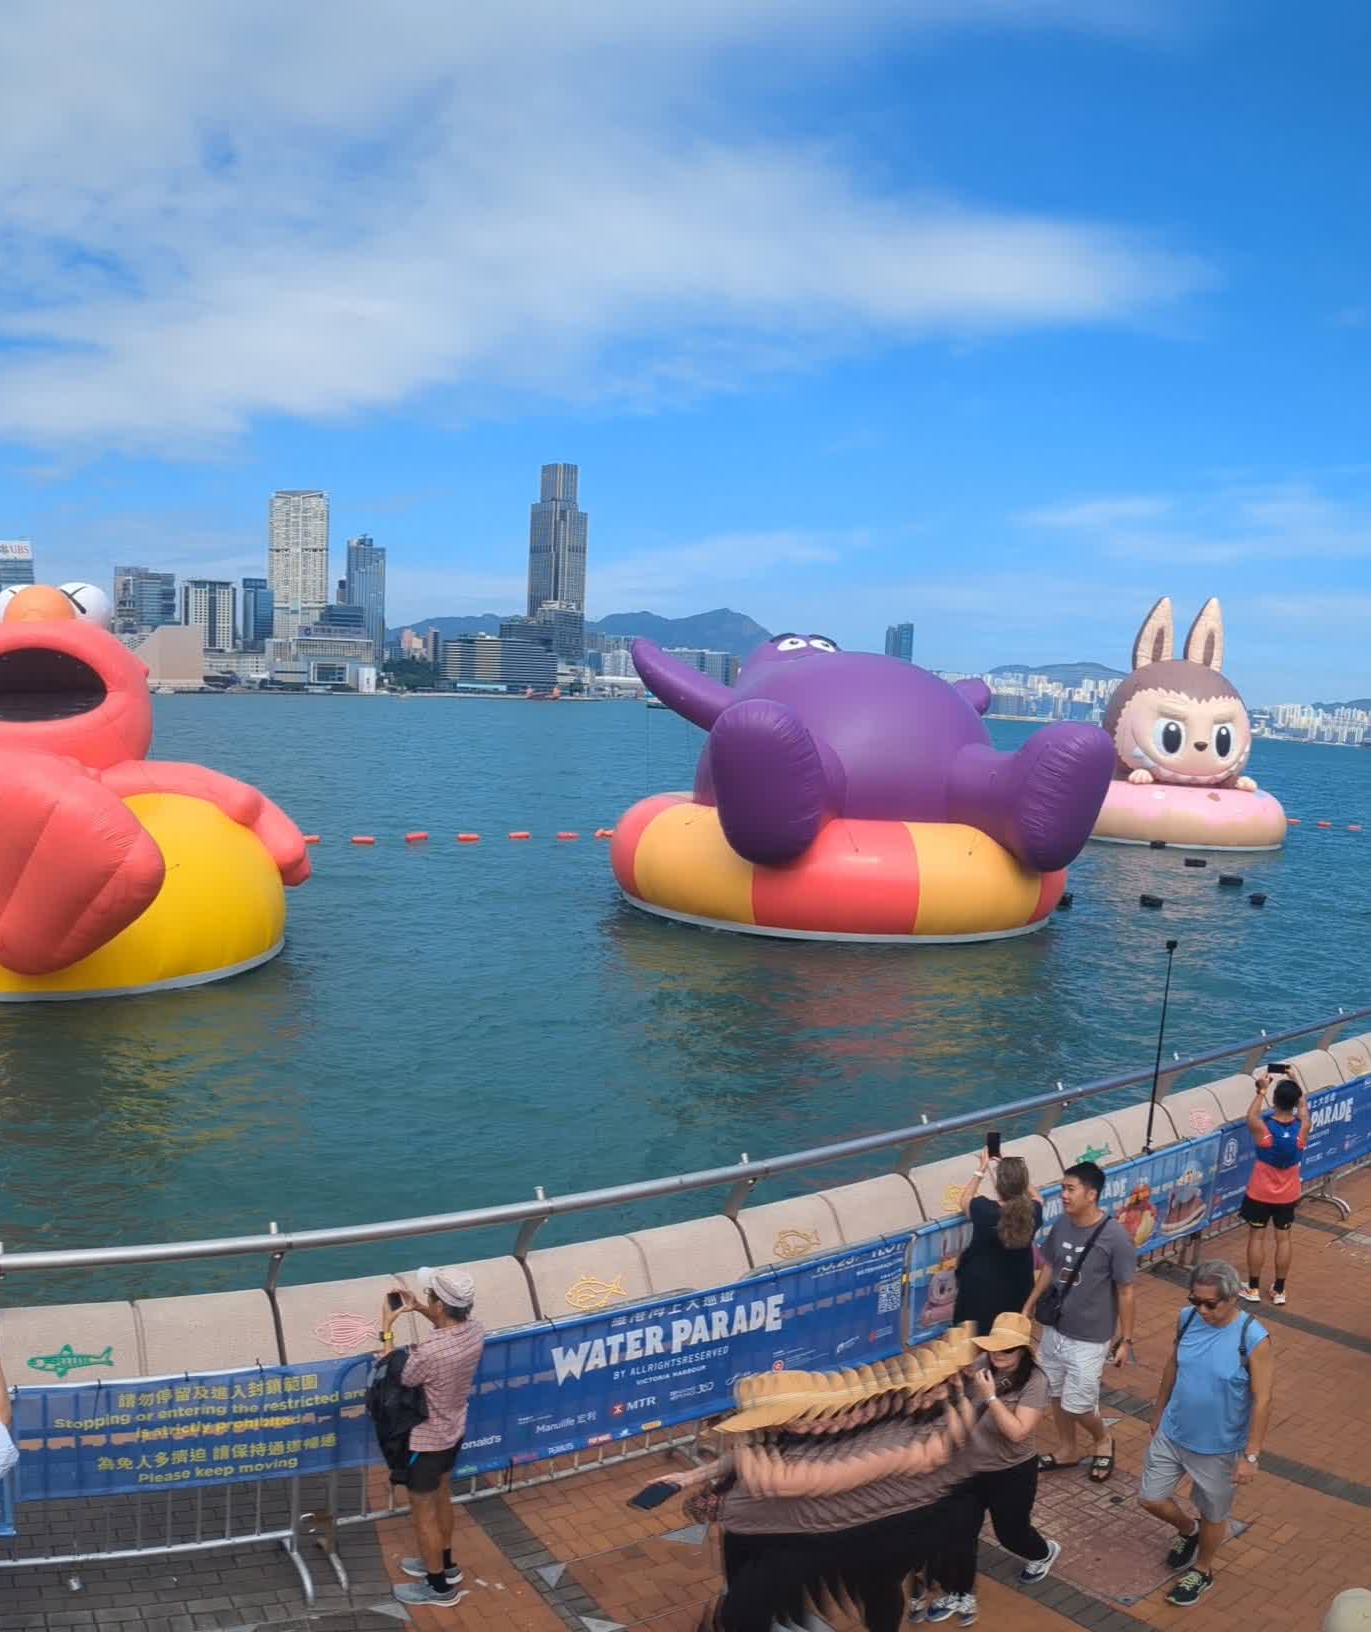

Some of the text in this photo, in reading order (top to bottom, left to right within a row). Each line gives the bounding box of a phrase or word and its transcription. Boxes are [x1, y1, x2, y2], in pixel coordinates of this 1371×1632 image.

[9, 545, 29, 554] UBS
[1309, 1097, 1354, 1133] PARADE
[551, 1293, 784, 1387] WATER PARADE
[613, 1345, 729, 1380] BY ALLRIGHTSRESERVED
[672, 1365, 707, 1377] HARBOUR
[53, 1413, 131, 1430] Stopping
[135, 1412, 153, 1422] or
[157, 1404, 227, 1419] entering
[232, 1403, 259, 1414] the
[263, 1391, 340, 1412] restricted
[626, 1396, 657, 1411] MTR
[153, 1421, 212, 1439] strictly
[212, 1412, 301, 1434] prohibited
[535, 1417, 575, 1433] Manulife
[461, 1434, 502, 1450] onald's
[138, 1457, 299, 1484] Please keep moving
